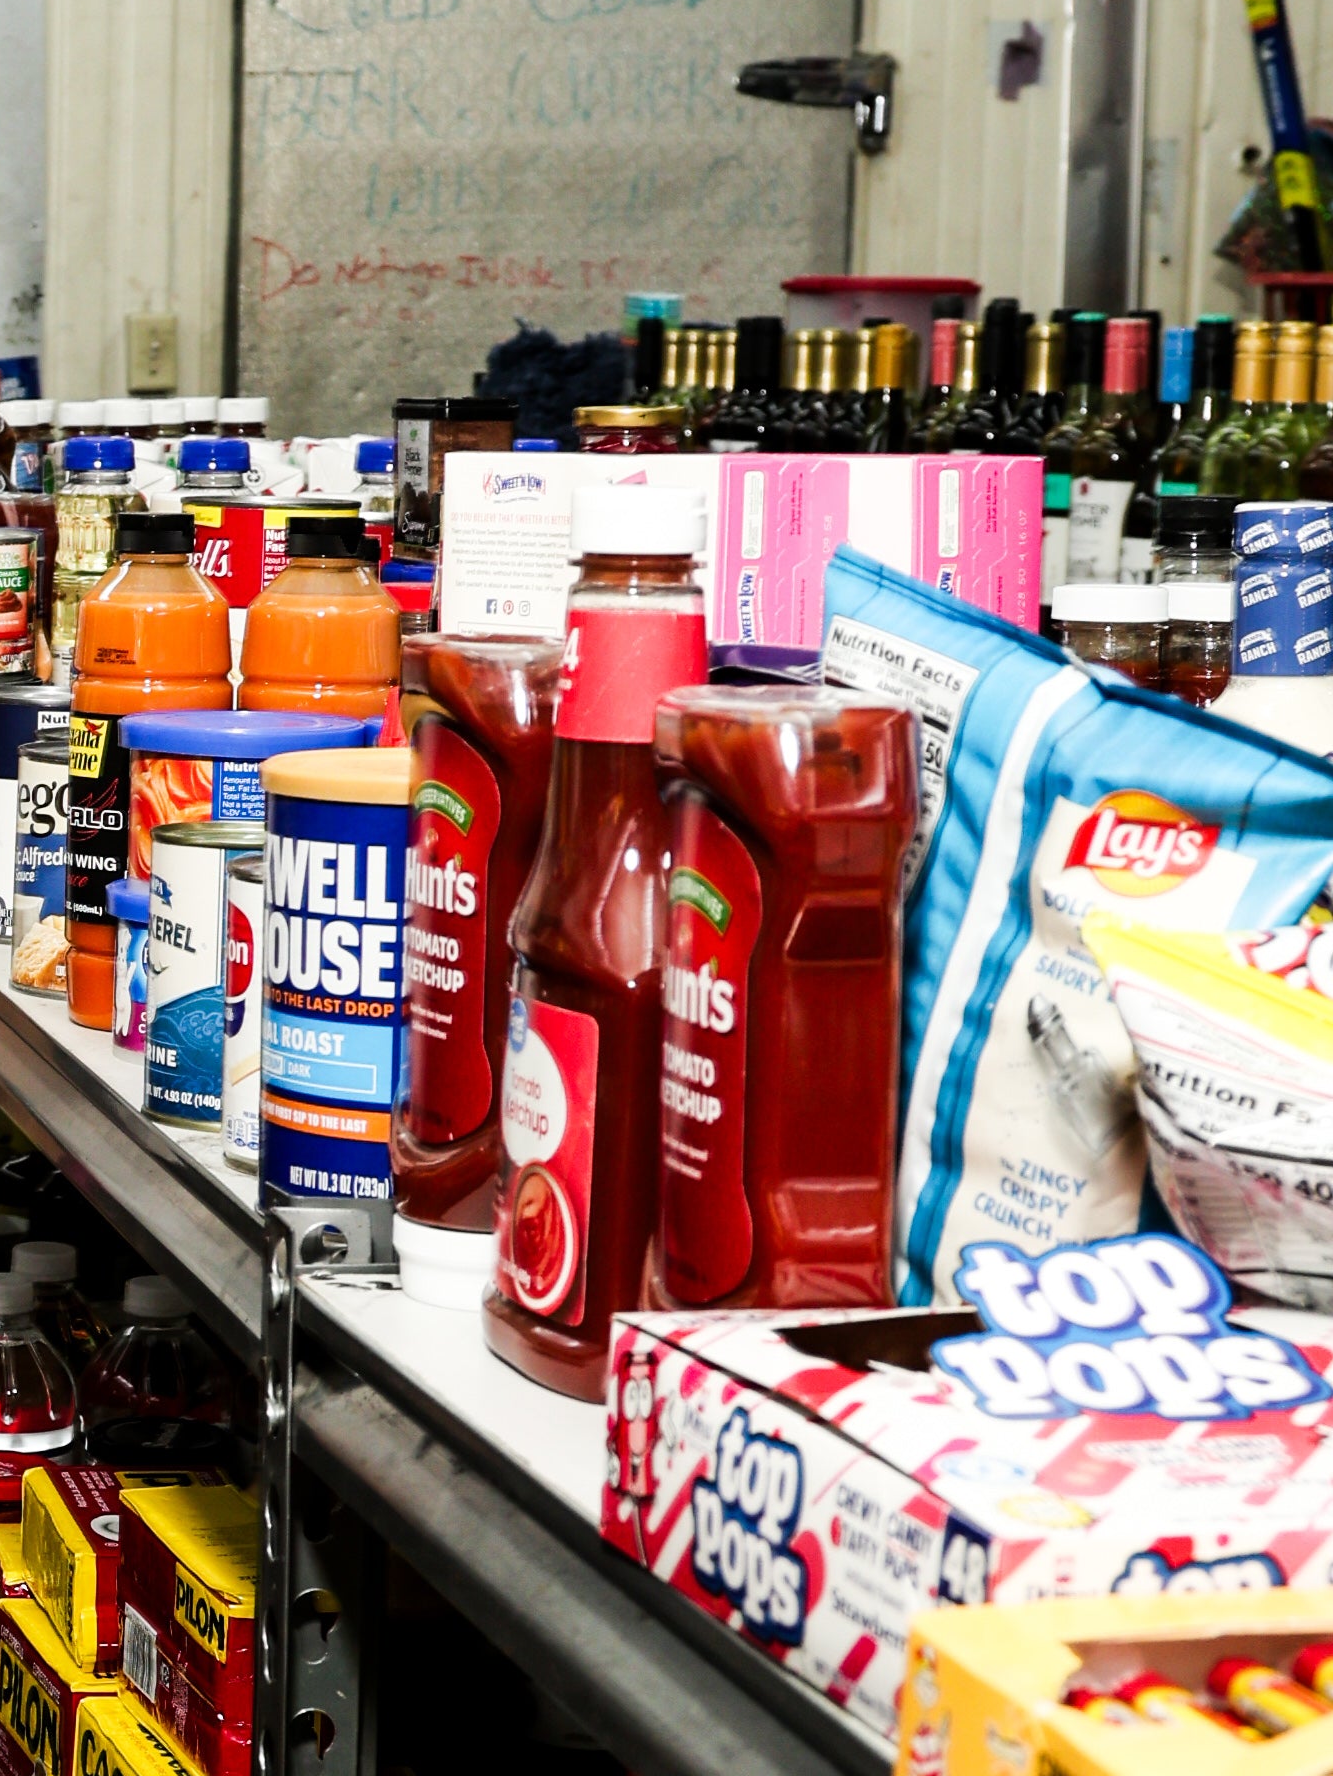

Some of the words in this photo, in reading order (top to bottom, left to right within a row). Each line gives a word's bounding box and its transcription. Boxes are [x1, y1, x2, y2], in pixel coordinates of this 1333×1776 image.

[1243, 531, 1279, 555] RANCH
[1241, 583, 1277, 608] RANCH
[1297, 584, 1332, 609] RANCH
[832, 627, 905, 667] Nutrition
[911, 658, 963, 692] Facts
[1241, 640, 1277, 664] RANCH
[1297, 640, 1331, 665] RANCH
[1086, 806, 1204, 879] Lay's
[75, 853, 117, 872] WING
[405, 847, 477, 916] Hunt's
[265, 915, 396, 998] OUSE
[1035, 955, 1102, 994] SAVORY
[283, 992, 304, 1008] THE
[306, 995, 341, 1014] LAST
[344, 1000, 395, 1018] DROP
[282, 1026, 345, 1056] ROAST
[288, 1062, 312, 1077] DARK
[164, 1090, 180, 1104] 4.93
[181, 1092, 193, 1106] OZ
[293, 1106, 307, 1123] SIP
[308, 1108, 320, 1126] TO
[320, 1109, 340, 1130] THE
[340, 1111, 367, 1133] LAST
[289, 1166, 303, 1185] NET
[303, 1168, 317, 1188] WT
[318, 1170, 339, 1193] 10.3
[339, 1174, 352, 1194] OZ
[1020, 1159, 1089, 1197] ZINGY
[999, 1177, 1070, 1220] CRISPY
[973, 1194, 1052, 1242] CRUNCH
[964, 1236, 1212, 1338] top
[941, 1333, 1313, 1416] pops
[718, 1413, 800, 1541] top
[693, 1486, 804, 1629] pops
[941, 1535, 989, 1606] 48
[175, 1576, 226, 1652] PILON
